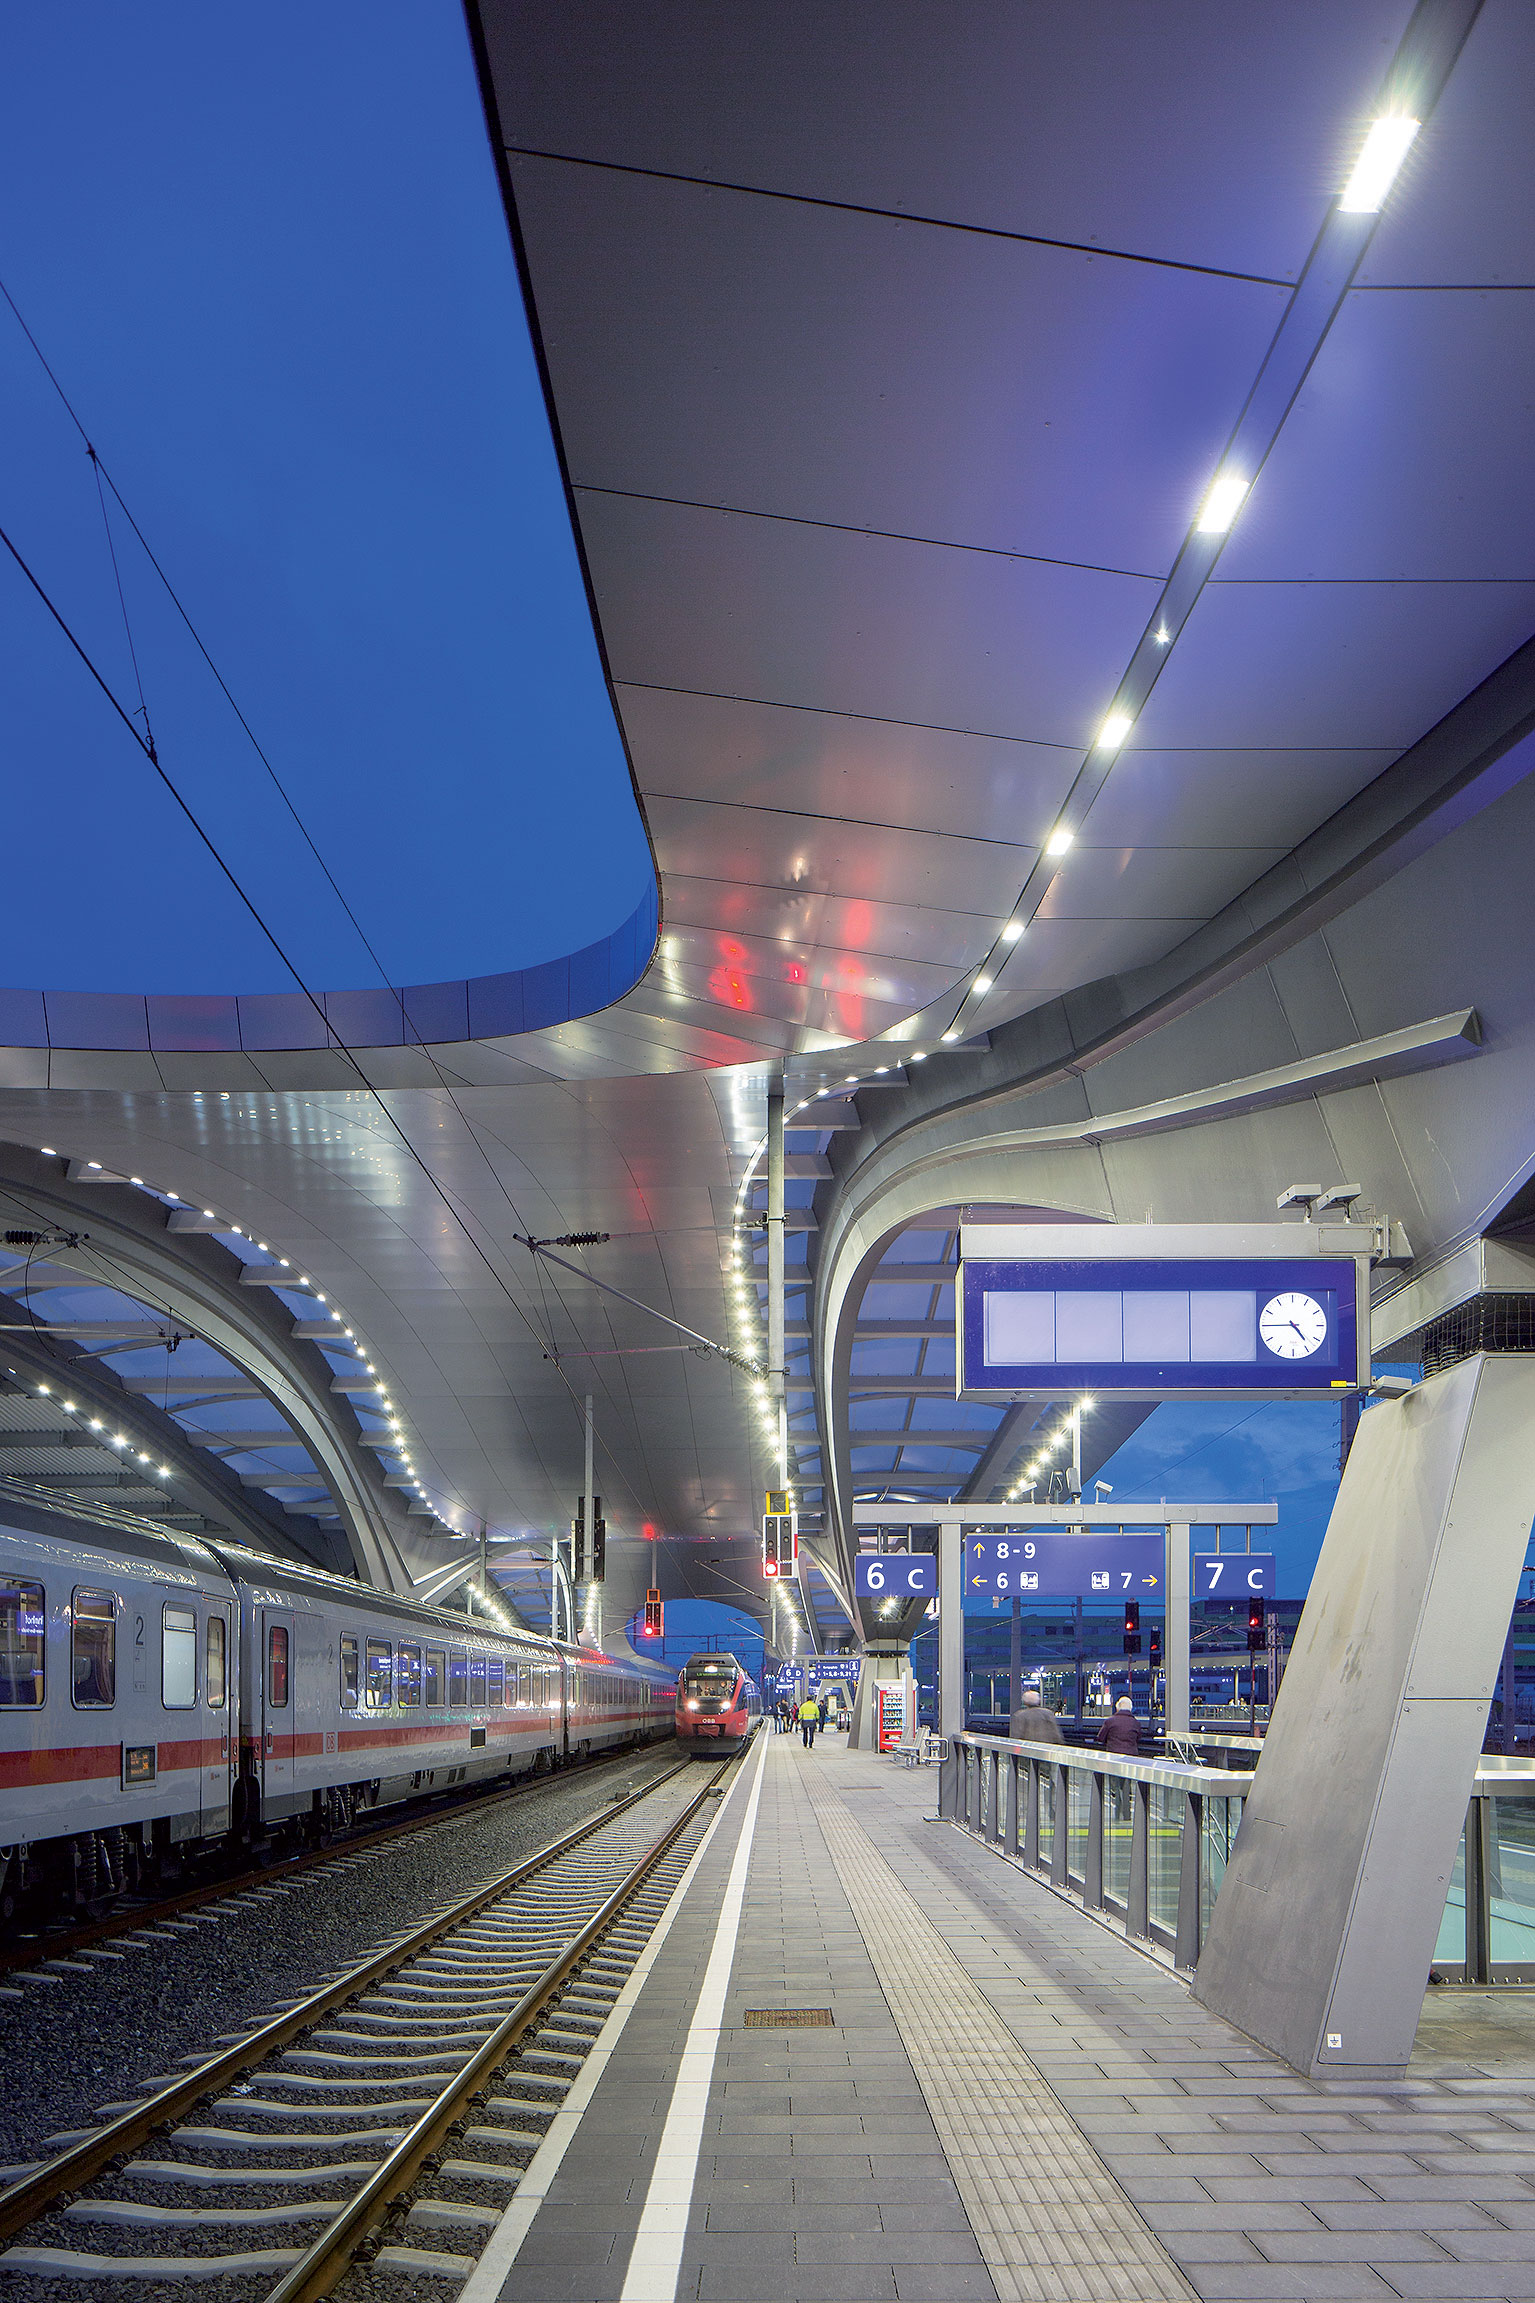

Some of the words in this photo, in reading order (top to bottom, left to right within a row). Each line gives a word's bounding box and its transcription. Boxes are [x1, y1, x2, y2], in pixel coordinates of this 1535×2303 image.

[996, 1542, 1036, 1560] 8-9
[866, 1562, 885, 1590] 6
[907, 1568, 924, 1590] C
[996, 1572, 1009, 1589] 6
[1120, 1572, 1133, 1589] 7
[1205, 1562, 1224, 1589] 7
[1247, 1568, 1264, 1590] C
[136, 1615, 144, 1646] 2
[328, 1643, 333, 1665] 2
[785, 1668, 792, 1677] 6
[795, 1669, 802, 1677] D
